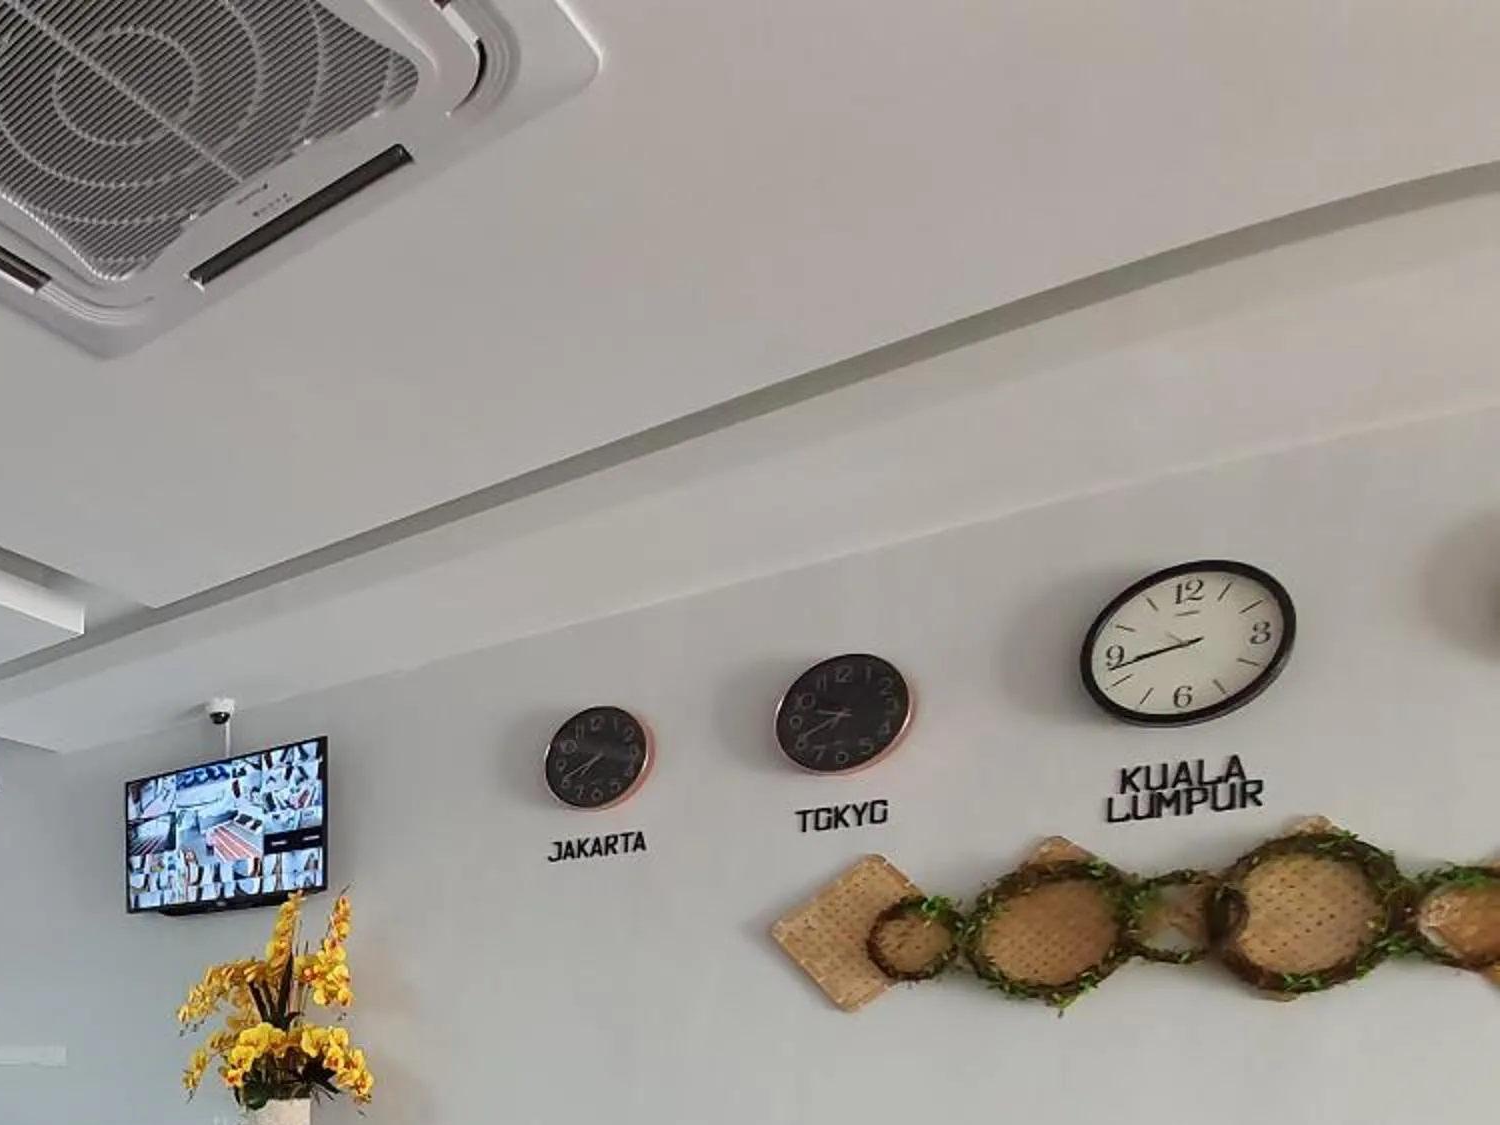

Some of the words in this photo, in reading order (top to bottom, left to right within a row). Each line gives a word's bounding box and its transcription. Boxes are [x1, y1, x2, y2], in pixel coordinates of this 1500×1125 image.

[1173, 579, 1204, 604] 12
[1250, 621, 1271, 644] 3
[1106, 644, 1125, 668] 9
[1173, 686, 1193, 708] 6
[1119, 754, 1247, 795] KUALA
[1105, 780, 1263, 823] LUMPUR
[794, 799, 889, 833] TOKYO
[547, 831, 647, 862] JAKARTA
